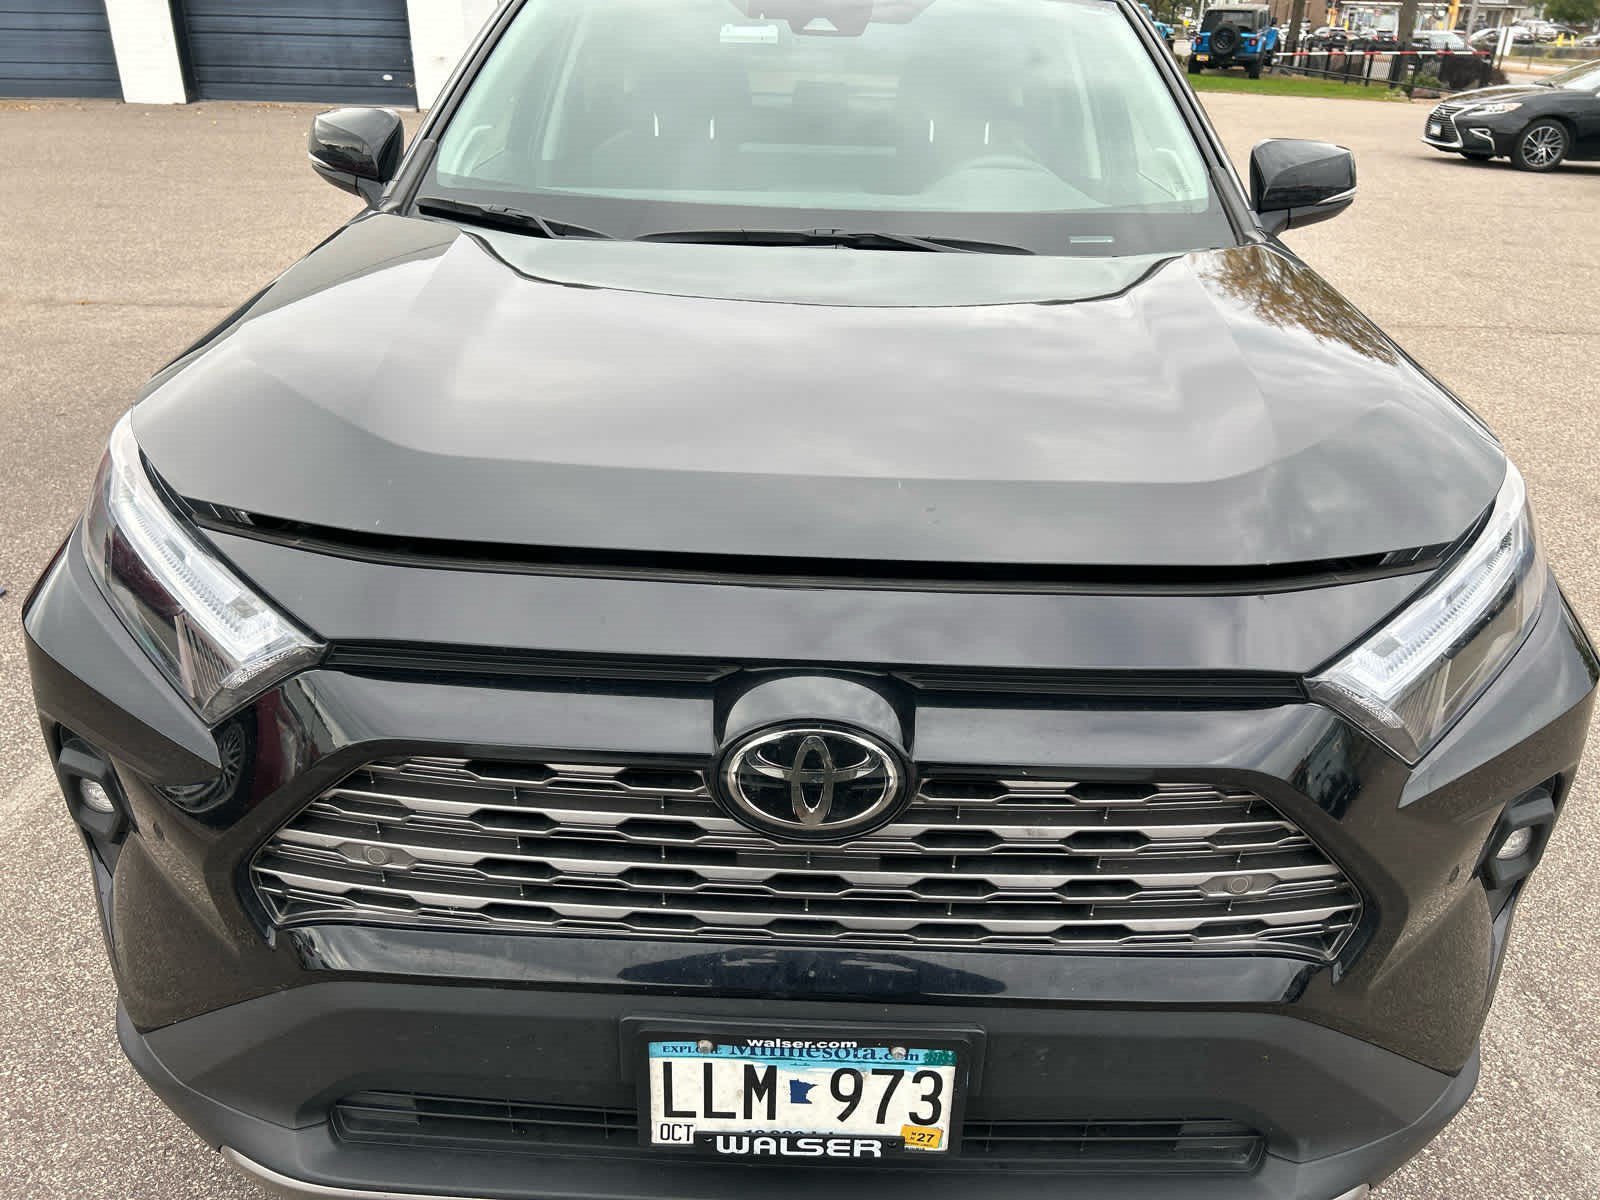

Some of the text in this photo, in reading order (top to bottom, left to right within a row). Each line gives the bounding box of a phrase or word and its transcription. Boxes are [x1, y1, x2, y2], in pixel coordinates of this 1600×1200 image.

[747, 1038, 858, 1049] walser.com
[729, 1044, 919, 1061] Minnesota.cm
[663, 1062, 943, 1126] LLM 973
[660, 1123, 693, 1141] OCT
[917, 1132, 935, 1143] 27
[716, 1135, 882, 1157] WALSER
